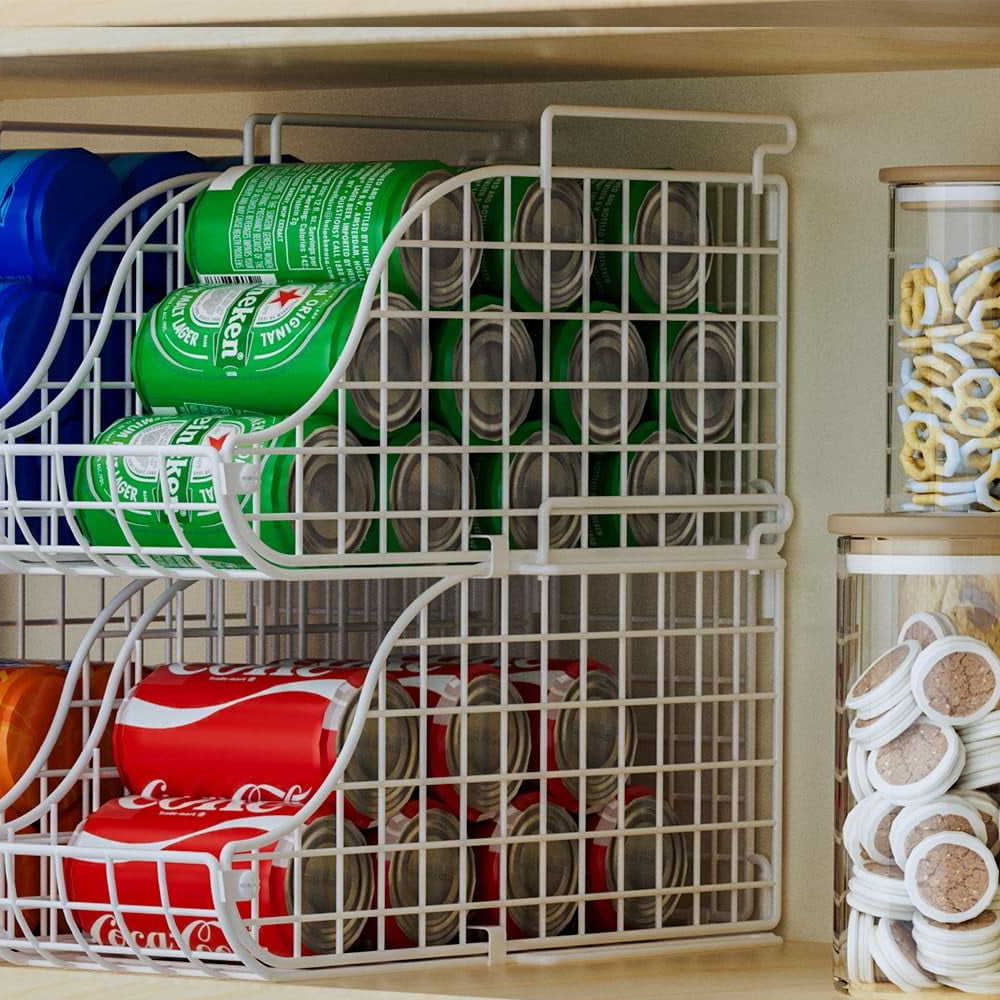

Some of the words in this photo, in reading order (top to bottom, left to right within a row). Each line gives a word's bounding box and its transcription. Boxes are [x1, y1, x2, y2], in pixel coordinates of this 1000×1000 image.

[332, 196, 346, 238] QUESTIONS?
[361, 202, 372, 232] BOTTLED
[342, 223, 350, 256] IMPORTED
[361, 235, 368, 243] BY
[344, 259, 350, 267] BY
[171, 319, 199, 347] LAGER
[260, 300, 318, 347] ORIGINAL
